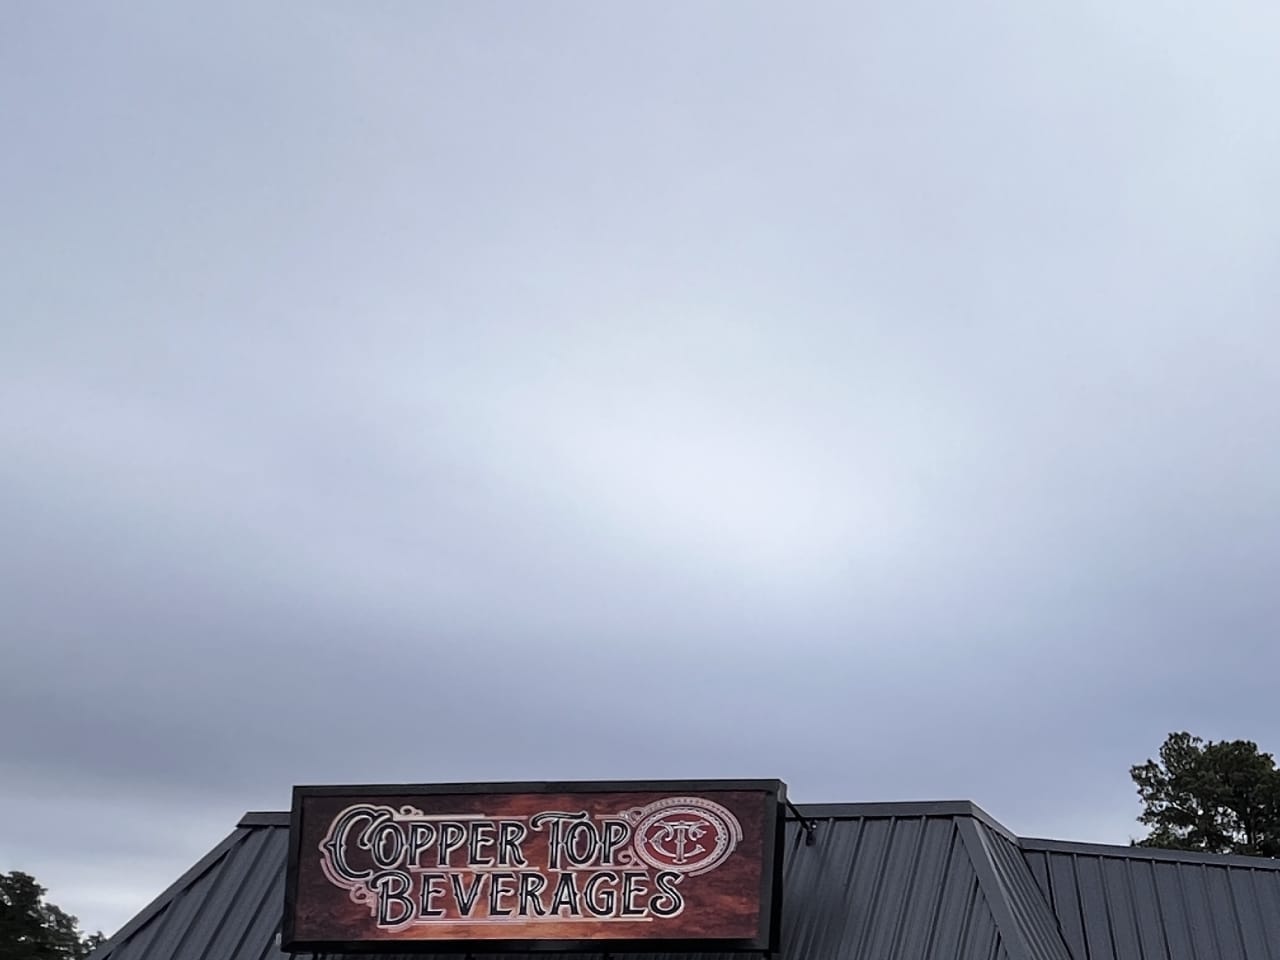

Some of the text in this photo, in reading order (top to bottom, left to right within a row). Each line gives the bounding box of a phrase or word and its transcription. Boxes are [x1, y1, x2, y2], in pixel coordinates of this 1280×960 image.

[322, 804, 633, 882] COPPER TOP
[371, 868, 685, 928] BEVERAGES
